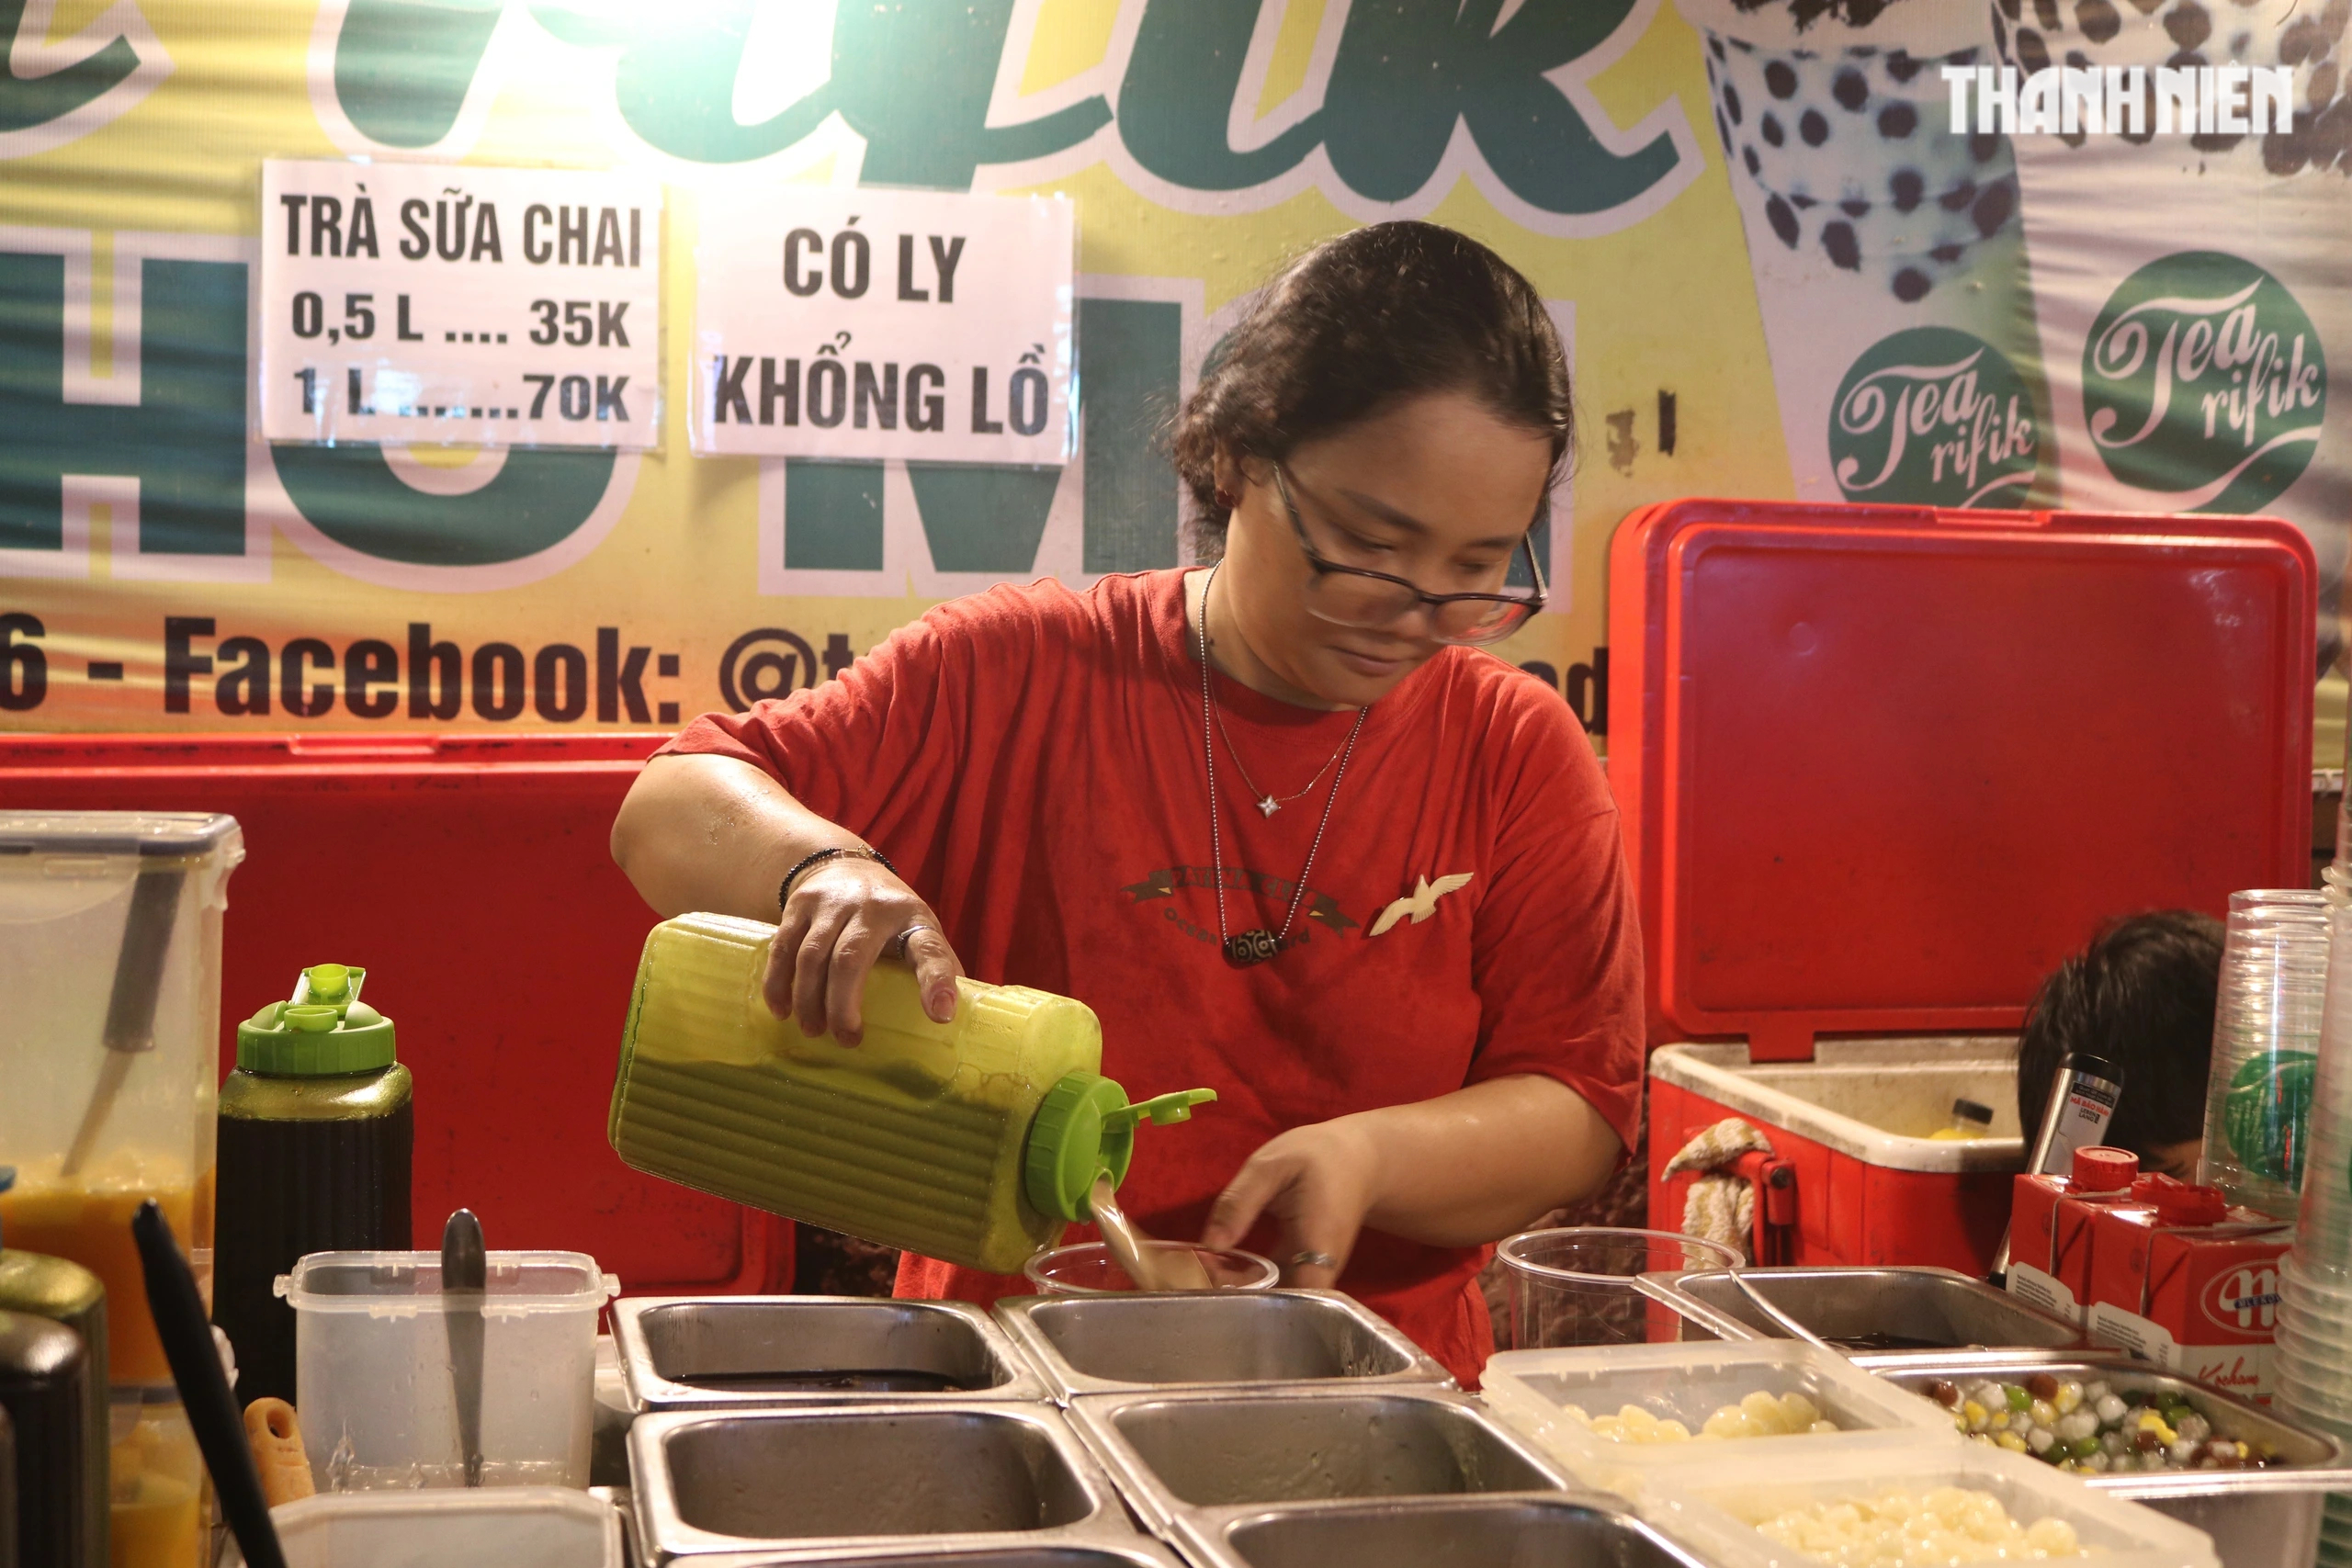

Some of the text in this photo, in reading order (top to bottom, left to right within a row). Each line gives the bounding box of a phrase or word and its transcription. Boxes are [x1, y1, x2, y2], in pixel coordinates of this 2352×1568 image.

[279, 182, 641, 268] TRÀ SỮA CHAI
[783, 215, 967, 304] CÓ LY
[291, 290, 376, 347] 0,5
[397, 294, 424, 343] L
[528, 299, 631, 348] 35K
[2089, 275, 2265, 449] Tea
[293, 367, 317, 415] 1
[347, 367, 377, 416] L
[712, 330, 1050, 437] KHỔNG LỒ
[1837, 345, 1985, 492] Tea
[2200, 331, 2321, 448] rifik
[1930, 392, 2037, 491] rifik
[164, 616, 681, 725] Facebook:
